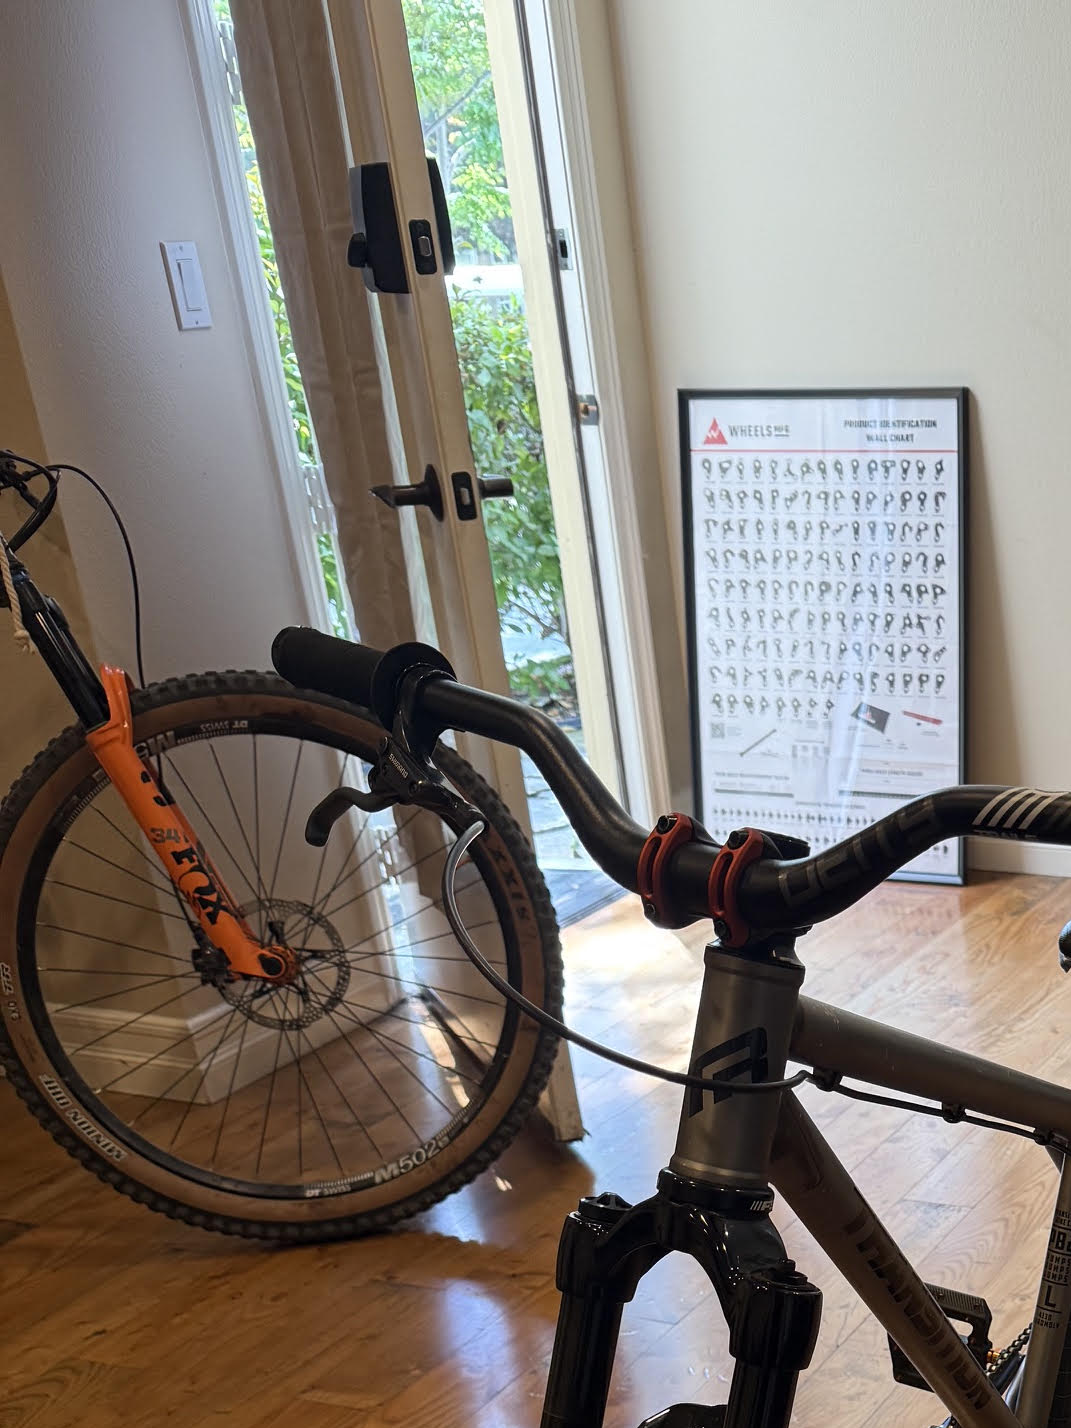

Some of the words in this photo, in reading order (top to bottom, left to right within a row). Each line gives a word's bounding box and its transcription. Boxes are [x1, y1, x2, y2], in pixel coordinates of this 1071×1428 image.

[728, 424, 773, 438] WHEELS
[843, 419, 877, 428] PRODUCT
[879, 419, 937, 429] IDENTIFICATION
[865, 433, 887, 442] WALL
[889, 433, 914, 443] CHART
[170, 847, 238, 926] FOX
[66, 1109, 128, 1162] MINION
[1044, 1285, 1056, 1308] L
